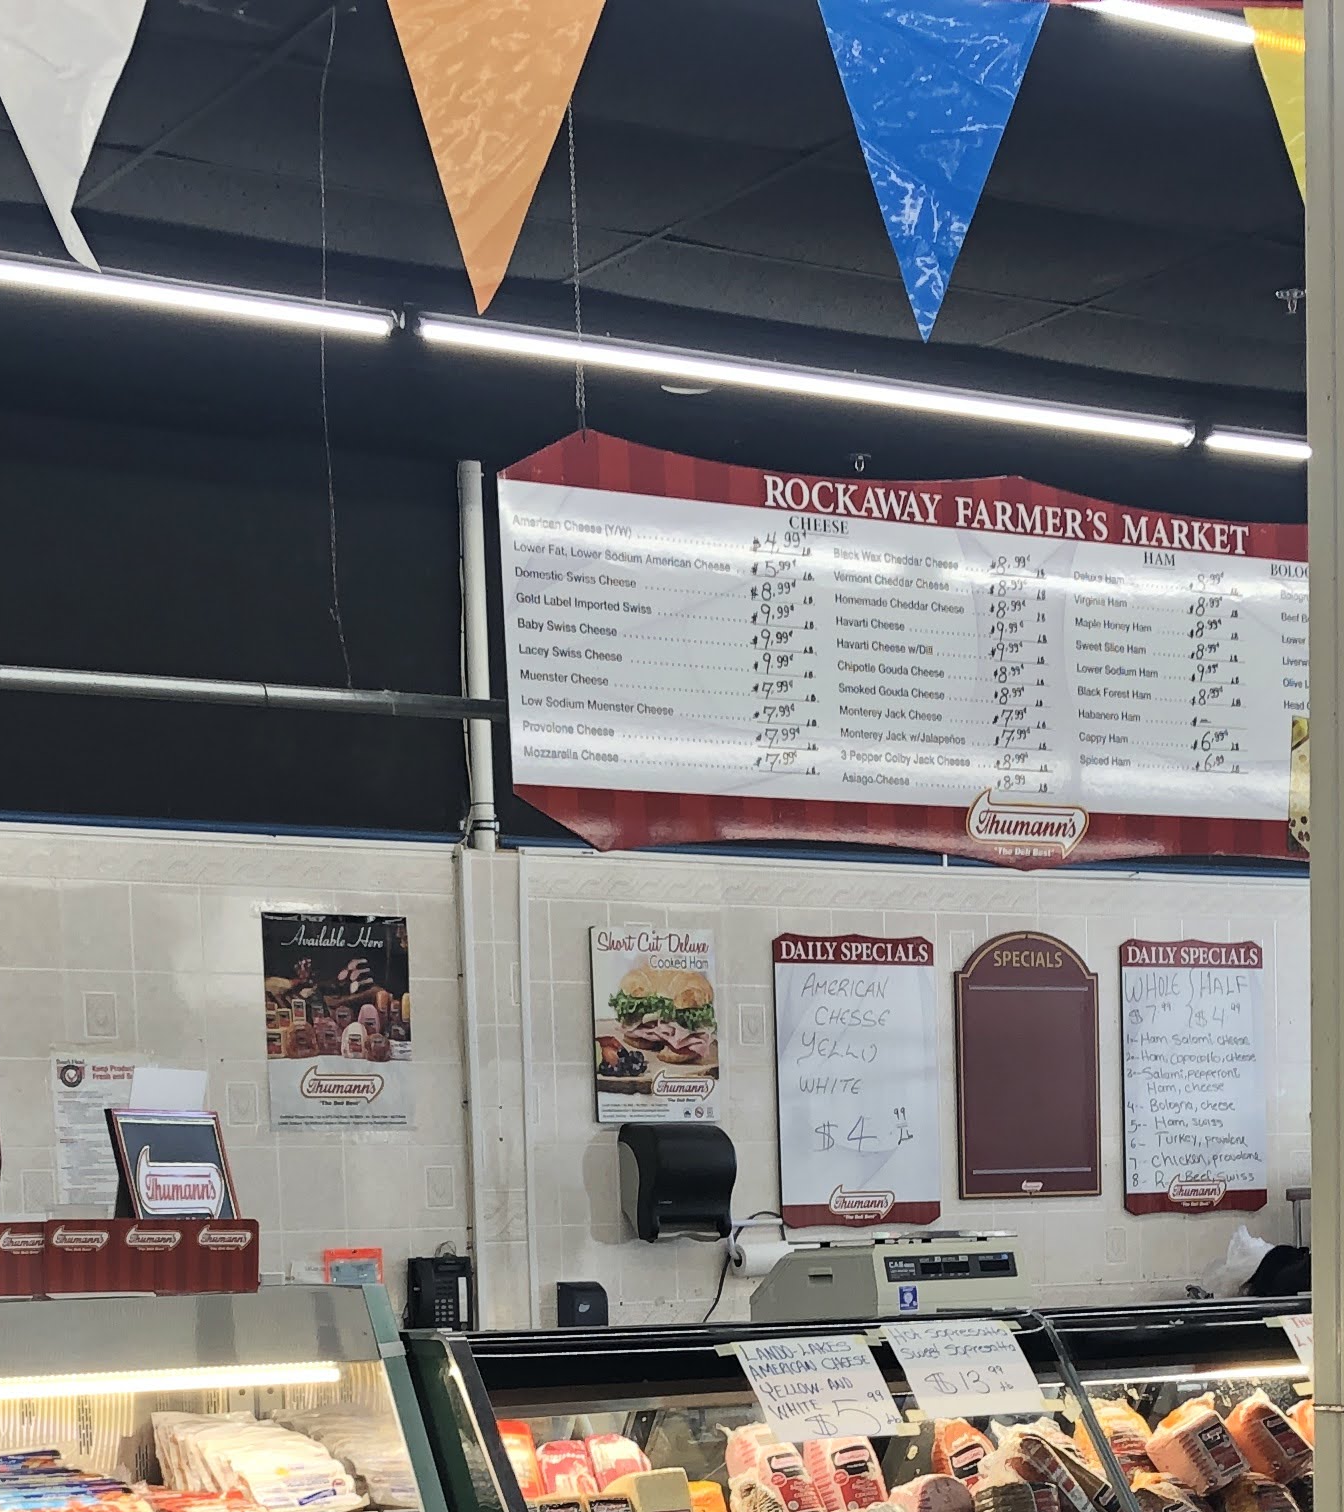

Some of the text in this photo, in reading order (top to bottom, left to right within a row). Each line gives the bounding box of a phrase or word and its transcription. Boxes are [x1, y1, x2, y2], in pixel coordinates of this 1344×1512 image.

[764, 474, 1249, 554] ROCKAWAY FARMER'S MARKET
[789, 515, 849, 535] CHEESE
[514, 541, 730, 572] Lower Fat, Lower Sodium American Cheese
[1143, 552, 1175, 566] HAM
[515, 567, 636, 589] Domestic Swiss Cheese
[516, 593, 652, 615] Gold Label Imported Swiss
[835, 594, 964, 615] Homemade Cheddar Cheese
[518, 618, 617, 637] Baby Swiss Cheese
[836, 616, 905, 632] Havarti Cheese
[1075, 617, 1152, 632] Maple Honey Ham
[519, 644, 622, 663] Lacey Swiss Cheese
[837, 638, 905, 654] Havarti Cheese
[1076, 640, 1146, 655] Sweet Slice Ham
[520, 669, 609, 686] Muenster Cheese
[838, 660, 944, 678] Chipotle Gouda Cheese
[1076, 664, 1158, 678] Lower Sodium Ham
[838, 683, 944, 700] Smoked Gouda Cheese
[1077, 686, 1151, 700] Black Forest Ham
[521, 695, 673, 717] Low Sodium Muenster Cheese
[840, 706, 942, 722] Monterey Jack Cheese
[1079, 710, 1141, 722] Habanero Ham
[523, 721, 614, 737] Provolone Cheese
[840, 728, 966, 746] Monterey Jack w/Jalapeños
[1079, 733, 1128, 745] Cappy Ham
[976, 807, 1076, 838] Thumann's
[280, 924, 384, 949] Available Here
[597, 930, 709, 953] Short Cut Deluxe
[781, 941, 928, 962] DAILY SPECIALS
[994, 951, 1062, 969] SPECIALS
[1127, 946, 1258, 965] DAILY SPECIALS
[650, 955, 708, 969] Cooked Ham
[801, 972, 889, 998] AMERICAN
[1125, 971, 1248, 1003] WHOLE HALF
[1141, 1033, 1213, 1045] Ham Salami
[308, 1077, 377, 1096] Thumann's
[657, 1080, 709, 1093] Thumann's
[799, 1076, 863, 1095] WHITE
[1185, 1082, 1224, 1093] cheese
[1150, 1098, 1235, 1113] Bologna, cheese
[1155, 1116, 1188, 1129] Ham,
[145, 1174, 217, 1201] Thumann's
[1173, 1185, 1220, 1196] Thumann's
[834, 1194, 888, 1209] Thumann's
[56, 1232, 109, 1246] Thumann's
[128, 1232, 181, 1246] Thumann's
[200, 1232, 252, 1246] Thumann's
[888, 1328, 921, 1345] Hot
[900, 1344, 940, 1360] Sweet
[749, 1355, 871, 1381] AMERICAN CHEESE
[828, 1377, 854, 1391] AND
[768, 1398, 822, 1421] WHITE
